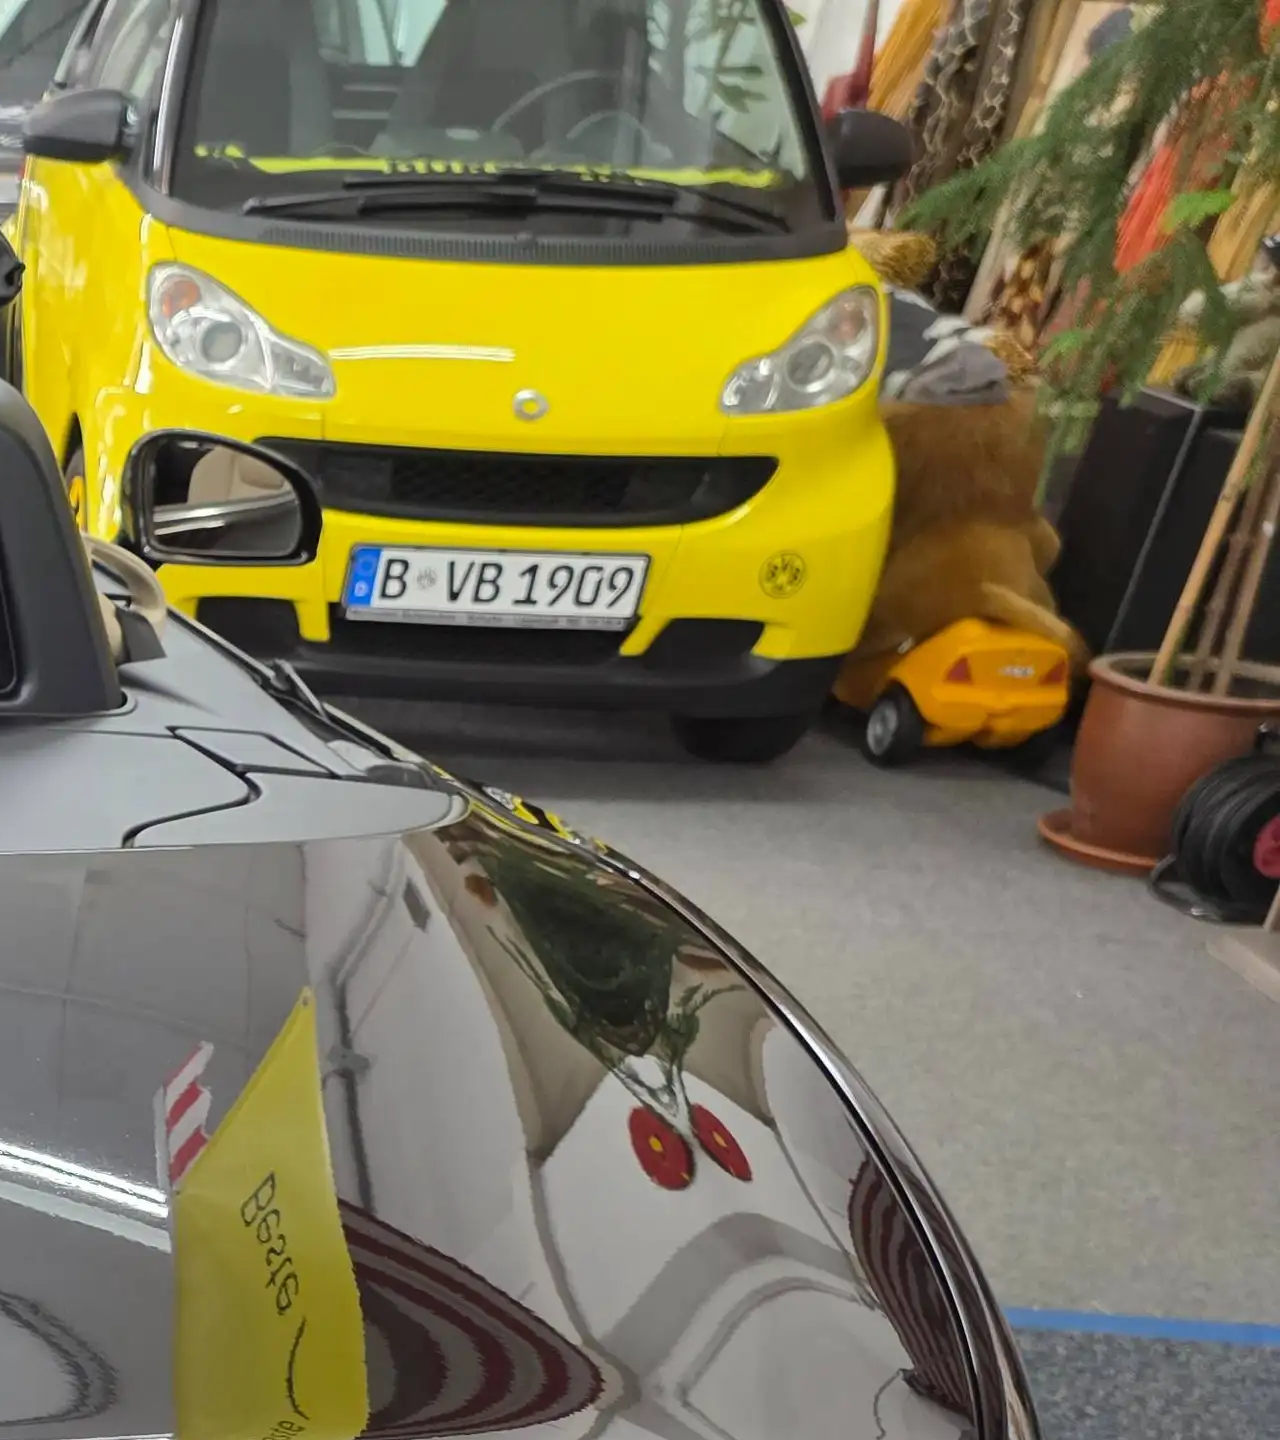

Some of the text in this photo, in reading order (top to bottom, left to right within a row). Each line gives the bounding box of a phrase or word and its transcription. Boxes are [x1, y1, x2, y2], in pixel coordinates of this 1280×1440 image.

[379, 558, 410, 600] B
[446, 560, 504, 603] VB
[512, 564, 635, 608] 1909
